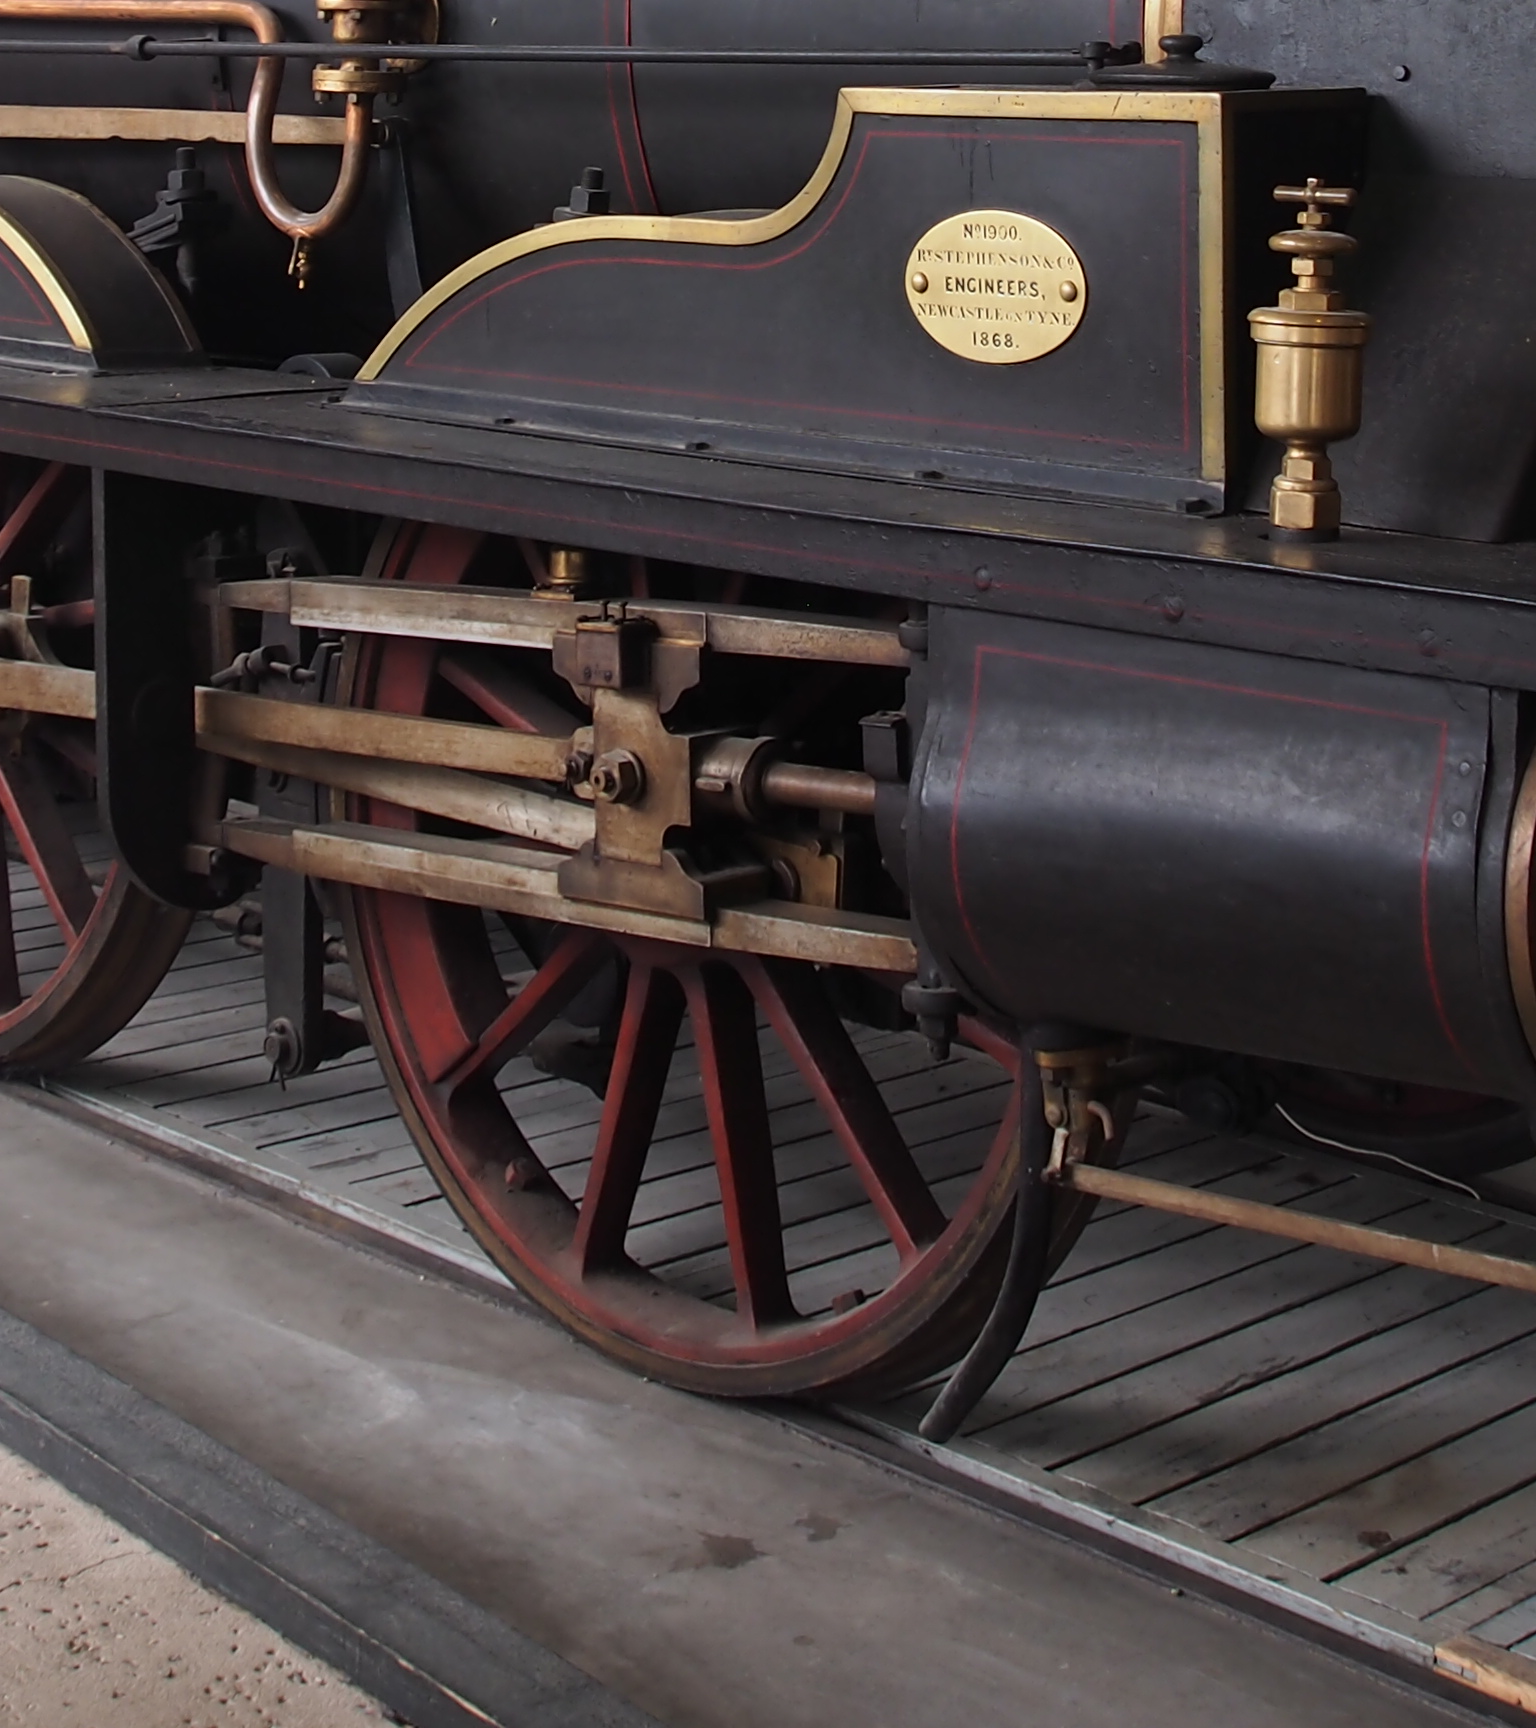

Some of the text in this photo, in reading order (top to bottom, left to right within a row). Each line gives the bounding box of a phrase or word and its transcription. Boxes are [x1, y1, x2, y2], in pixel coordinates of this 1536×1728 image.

[945, 276, 1046, 301] ENGINEERS,
[916, 303, 1004, 321] NEWCASTLE
[972, 331, 1020, 349] 1868.
